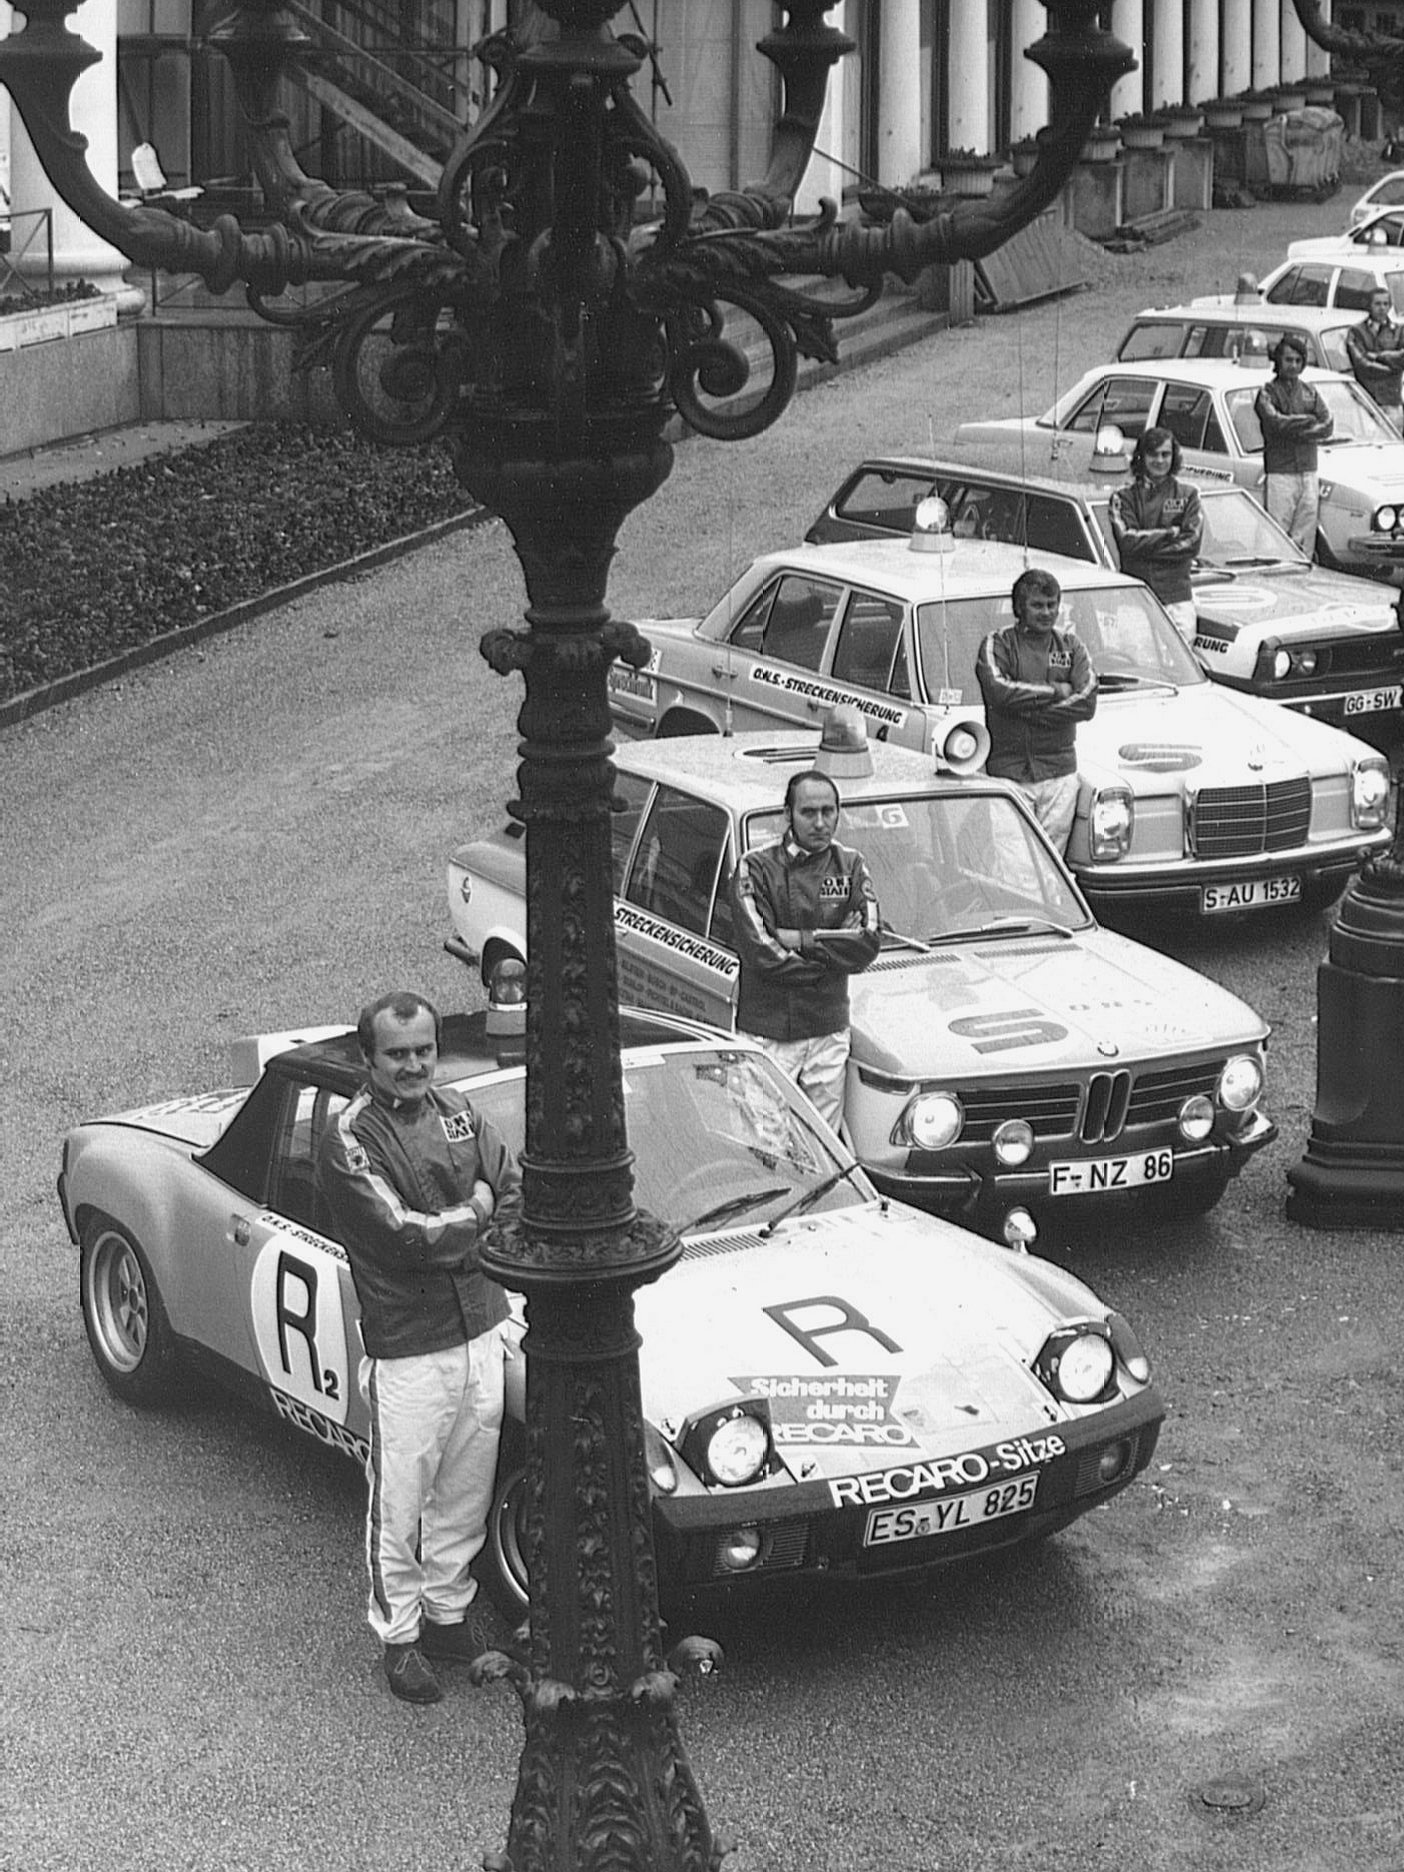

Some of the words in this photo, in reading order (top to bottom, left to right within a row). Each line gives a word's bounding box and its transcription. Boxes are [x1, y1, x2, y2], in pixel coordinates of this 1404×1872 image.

[1262, 877, 1301, 902] 1532
[1143, 1151, 1172, 1182] 86
[763, 1295, 905, 1367] R
[750, 1377, 890, 1399] Sicherheit
[806, 1399, 886, 1422] durch
[828, 1434, 1067, 1508] RECARO-Sitze
[983, 1477, 1038, 1518] 825
